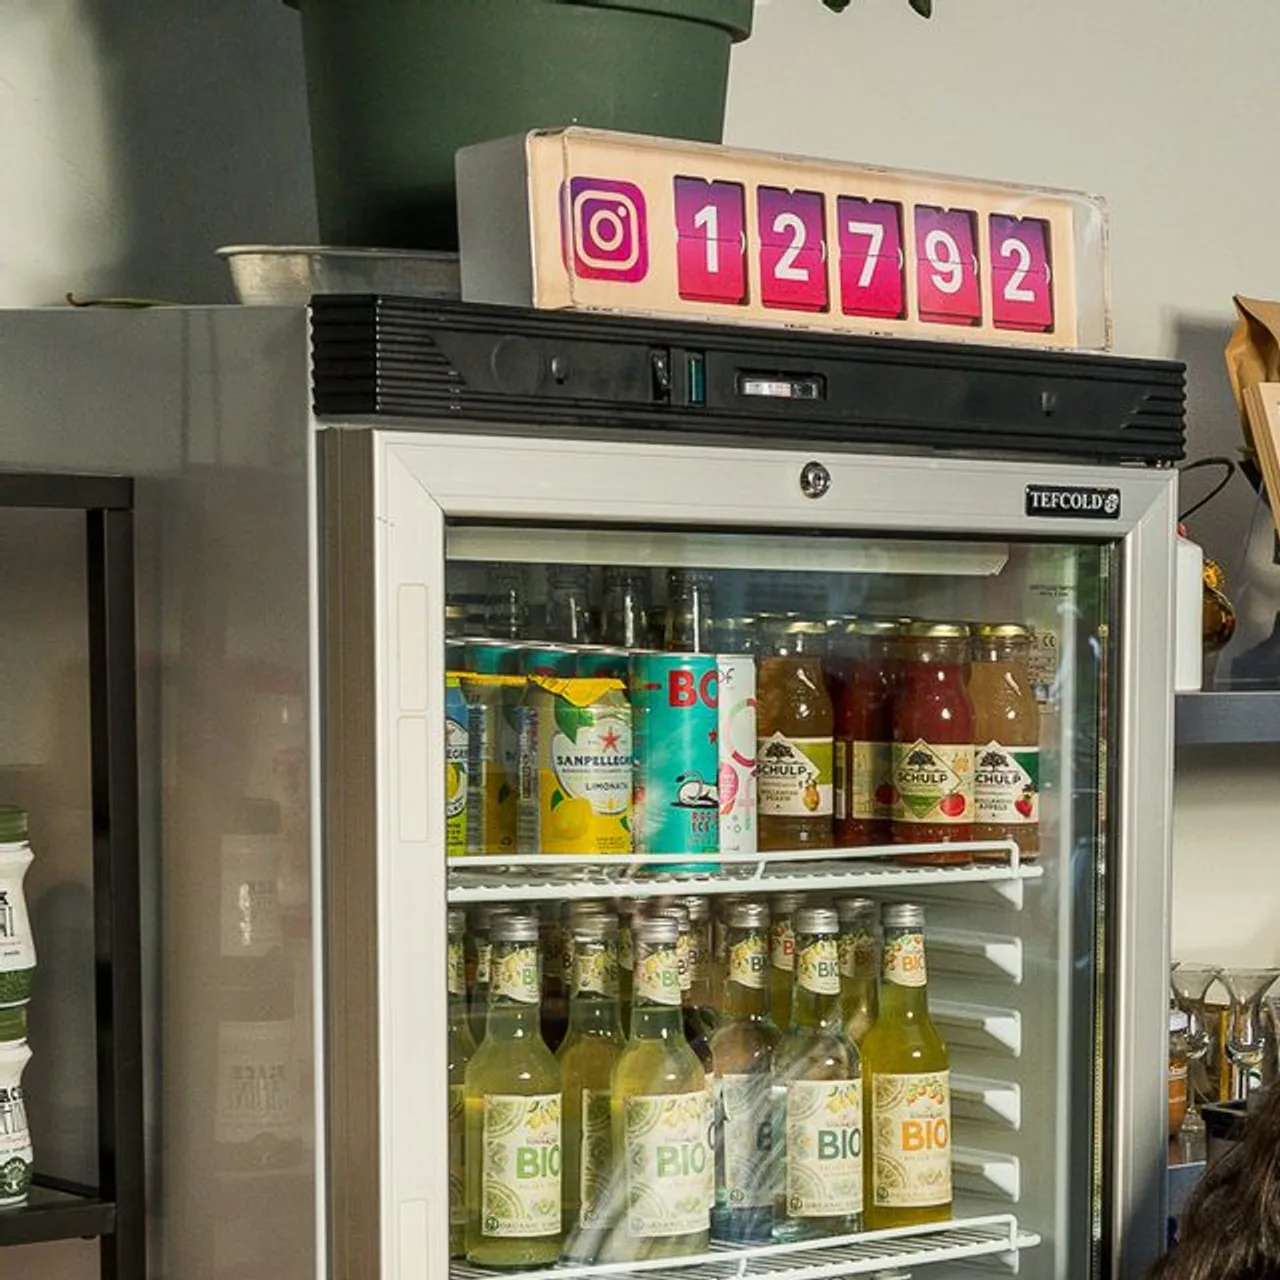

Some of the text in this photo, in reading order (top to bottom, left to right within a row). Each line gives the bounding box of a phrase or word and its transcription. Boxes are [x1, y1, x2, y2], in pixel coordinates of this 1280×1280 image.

[694, 203, 1034, 302] 12792
[1030, 491, 1103, 509] TEFCOLD
[902, 1118, 948, 1152] BIO
[657, 1143, 706, 1178] BIO
